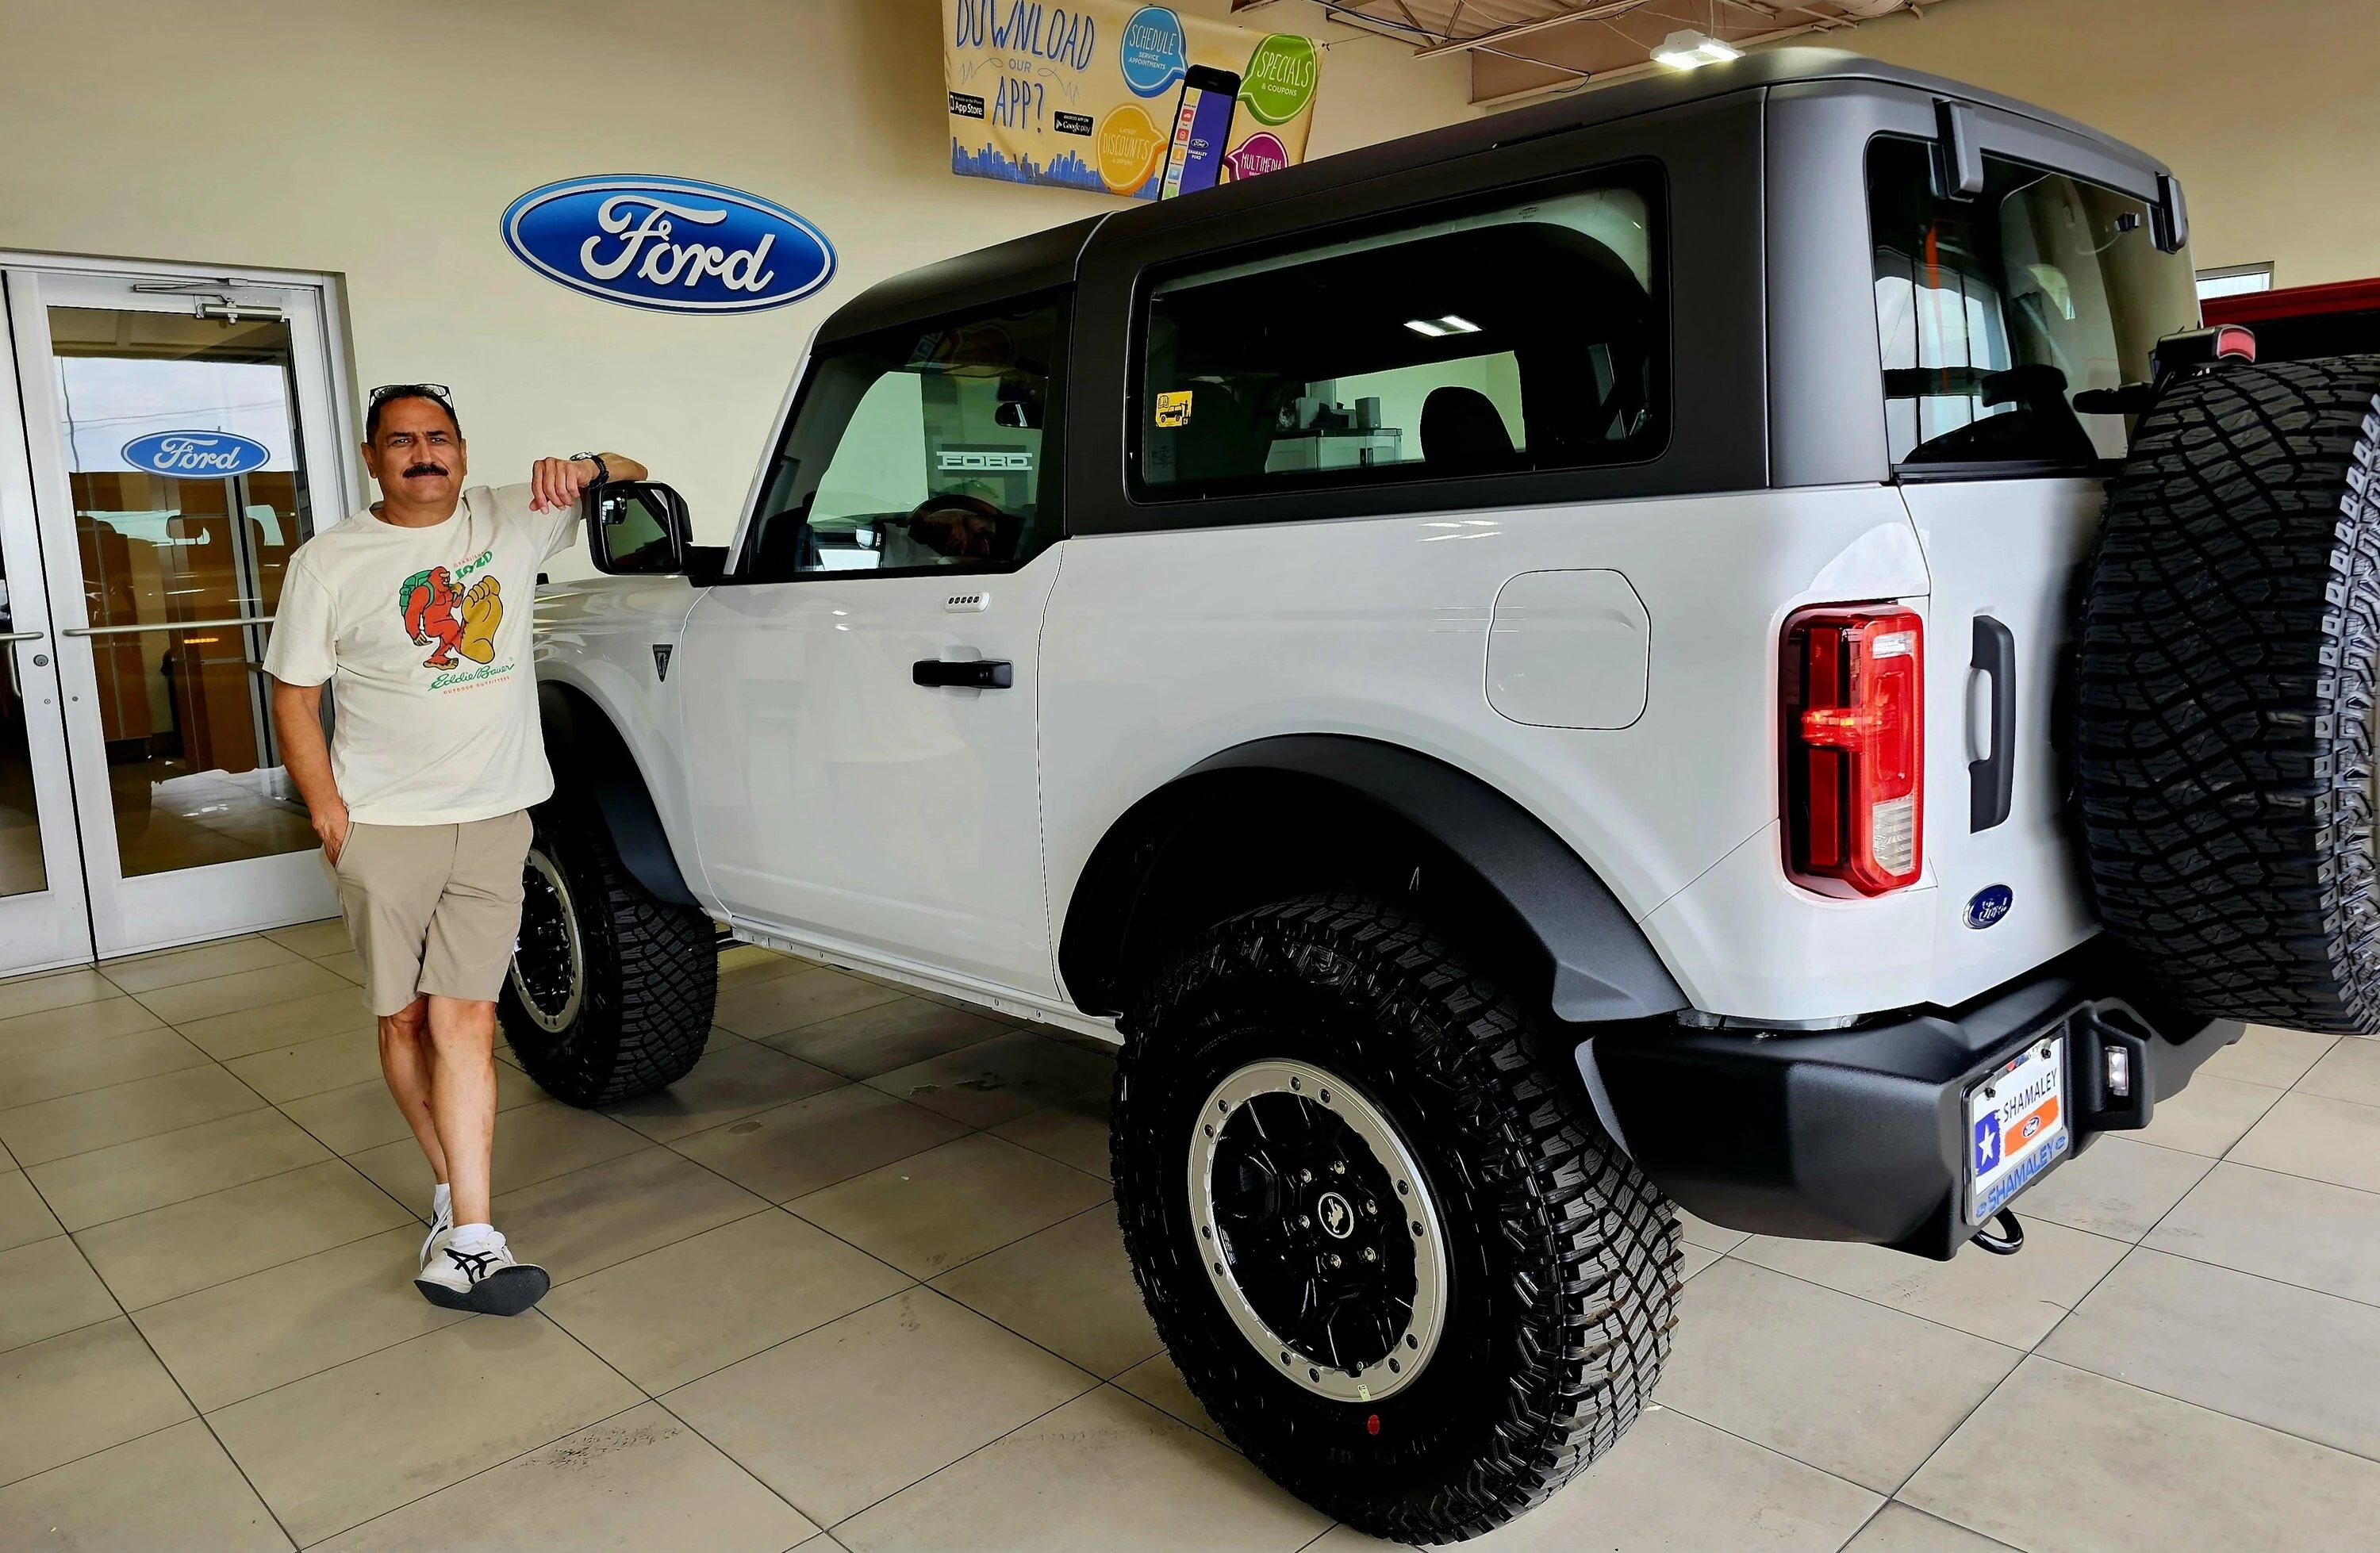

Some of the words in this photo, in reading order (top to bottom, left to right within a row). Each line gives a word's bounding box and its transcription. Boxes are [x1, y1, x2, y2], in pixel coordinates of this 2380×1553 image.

[957, 0, 1096, 71] DOWNLOAD
[1130, 25, 1177, 56] SCHEDULE
[1009, 58, 1031, 73] OUR
[1128, 57, 1166, 70] APPOINTMENTS
[1138, 52, 1159, 61] SERVICE
[1257, 51, 1311, 88] SPECIALS
[992, 75, 1045, 134] APP?
[1267, 84, 1297, 97] COUPONS
[955, 101, 967, 113] App
[967, 103, 983, 115] Store
[1063, 121, 1081, 132] Google
[1081, 125, 1091, 134] play
[1103, 132, 1150, 160] DISCOUNTS
[1241, 153, 1281, 173] MULTIMEDIA
[580, 194, 776, 292] Ford
[154, 437, 241, 470] Ford
[942, 455, 1028, 467] FORD
[428, 671, 477, 692] Eddie
[476, 664, 515, 680] Bauer
[443, 684, 474, 695] OUTDOOR
[476, 675, 510, 688] OUTFITTERS
[2003, 1067, 2058, 1123] SHAMALEY
[1987, 1137, 2056, 1213] SHAMALEY
